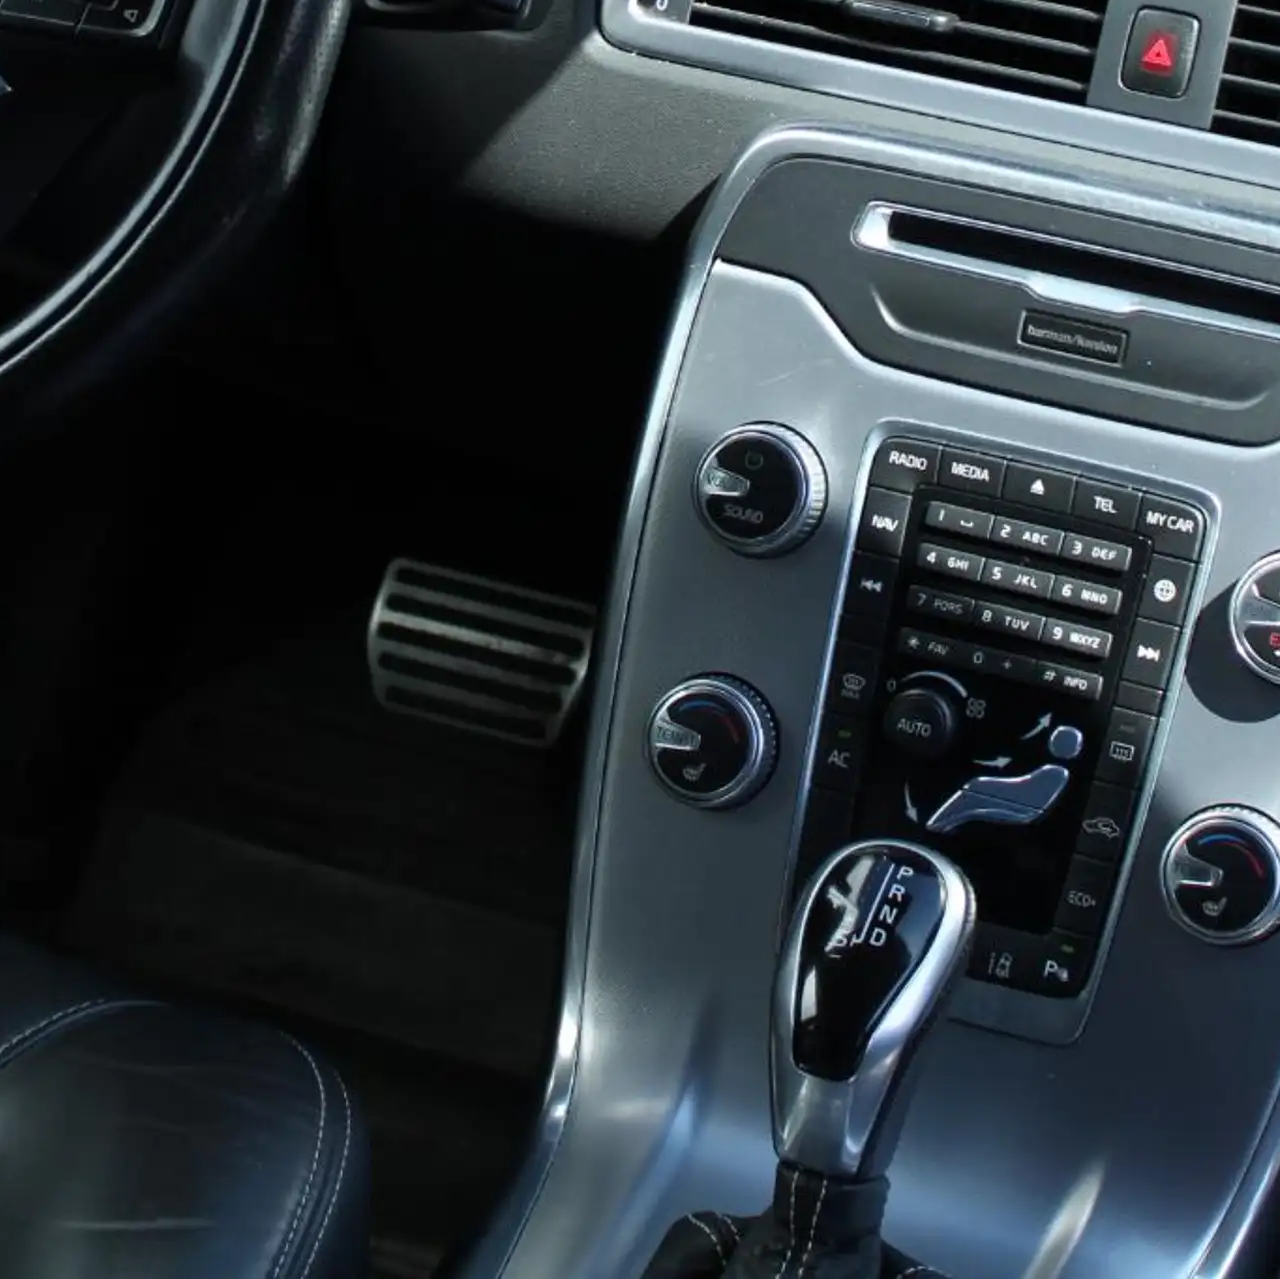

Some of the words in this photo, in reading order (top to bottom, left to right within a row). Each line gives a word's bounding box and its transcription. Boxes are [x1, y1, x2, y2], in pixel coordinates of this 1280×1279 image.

[888, 449, 928, 472] RADIO
[950, 459, 990, 482] MEDIA
[1093, 495, 1118, 515] TEL
[870, 513, 899, 533] NAV
[1145, 509, 1166, 527] MY
[1166, 514, 1195, 535] CAR
[999, 524, 1012, 538] 2
[1022, 530, 1048, 547] ABC
[1071, 539, 1083, 555] 3
[1092, 543, 1118, 561] DEF
[926, 550, 937, 565] 4
[946, 556, 969, 572] GHI
[991, 565, 1002, 581] 5
[1013, 572, 1039, 590] JKL
[916, 591, 927, 607] 7
[1061, 582, 1072, 598] 6
[1080, 587, 1108, 605] MNO
[981, 610, 993, 624] 8
[1004, 614, 1030, 632] TUV
[1051, 625, 1063, 642] 9
[1068, 629, 1101, 650] WXYZ
[927, 640, 948, 657] FAV
[972, 650, 983, 667] 0
[1063, 673, 1088, 692] INFO
[896, 717, 932, 738] AUTO
[826, 751, 851, 770] AC
[895, 863, 914, 882] P
[887, 885, 905, 904] R
[877, 907, 895, 925] N
[868, 928, 887, 947] D
